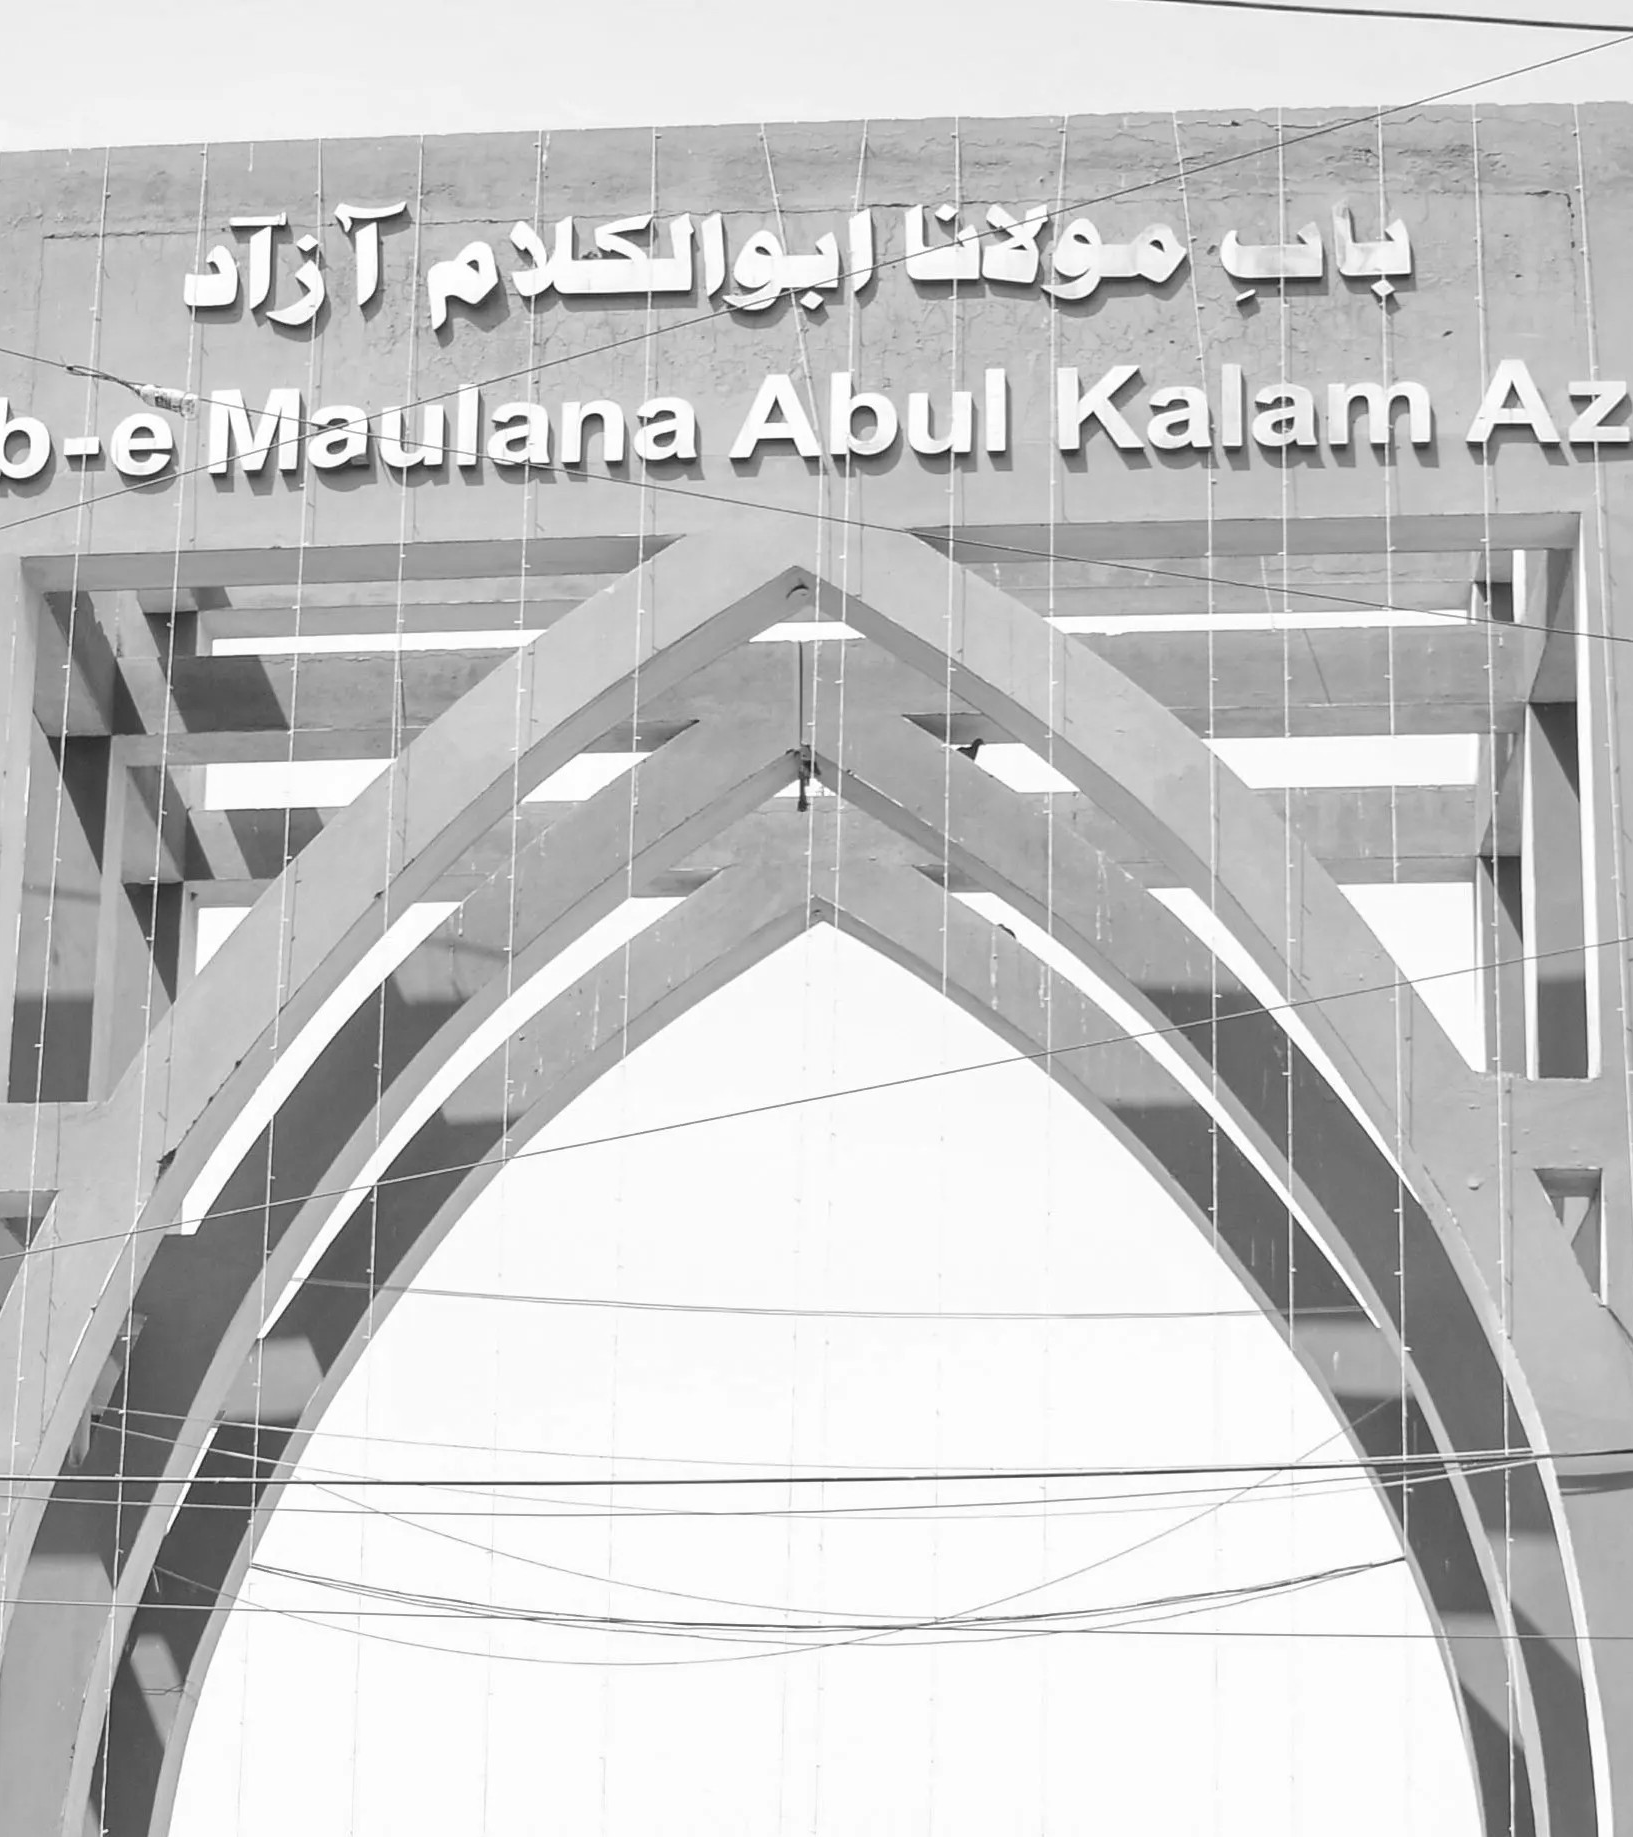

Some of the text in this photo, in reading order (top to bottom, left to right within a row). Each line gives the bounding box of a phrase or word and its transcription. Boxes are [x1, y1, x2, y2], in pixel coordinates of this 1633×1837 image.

[905, 203, 1187, 300] مولانا
[209, 384, 697, 475] Maulana
[728, 367, 1006, 460] Abul
[1057, 364, 1430, 451] Kalam
